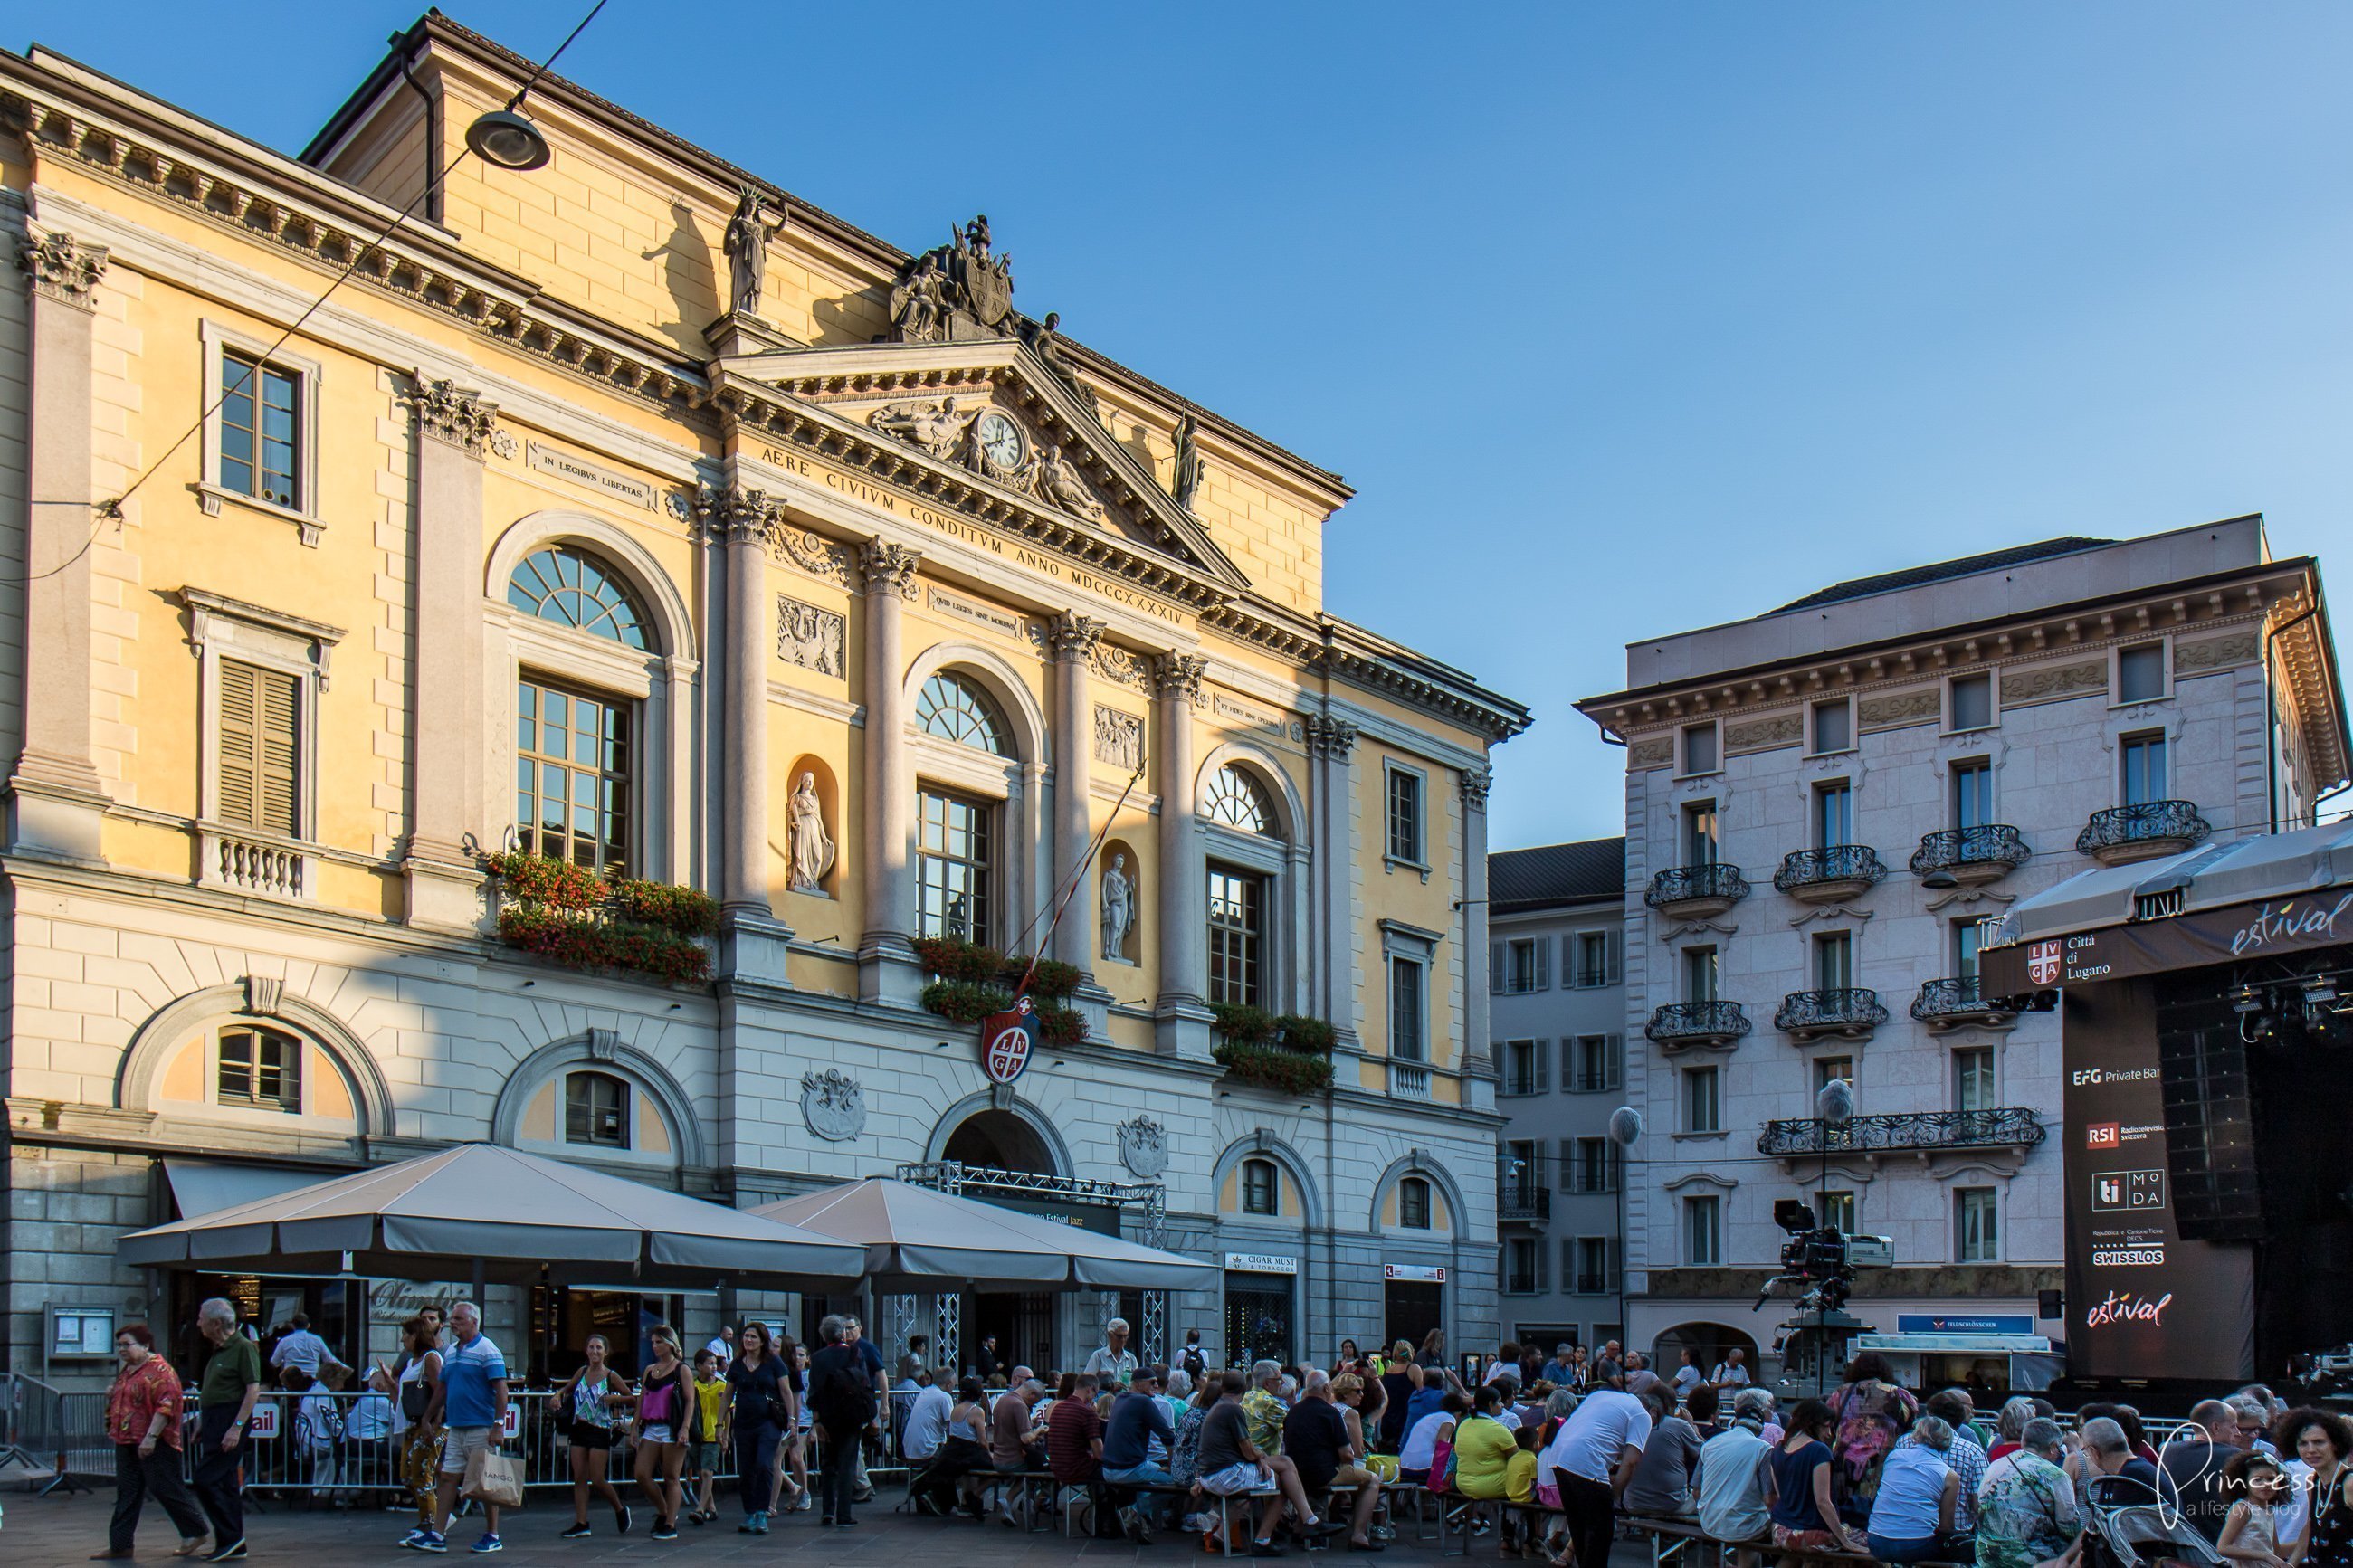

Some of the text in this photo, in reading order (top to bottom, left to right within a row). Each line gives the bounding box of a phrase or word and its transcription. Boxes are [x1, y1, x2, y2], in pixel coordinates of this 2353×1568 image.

[544, 456, 643, 498] IN LEGIBVS LIBERTAS
[762, 448, 1182, 623] AERE CIVIVM CONDITVM ANNO MDCCCXXXXIV
[2230, 892, 2353, 955] estival
[2067, 934, 2095, 949] Città
[2067, 952, 2078, 964] di
[2067, 964, 2110, 980] Lugano
[2073, 1069, 2101, 1086] EFG
[2105, 1069, 2141, 1082] Private
[2089, 1127, 2115, 1143] RSI
[2120, 1133, 2147, 1141] svizzera
[2101, 1179, 2119, 1203] ti
[1070, 1216, 1084, 1226] Jazz
[1248, 1255, 1294, 1266] CIGAR MUST
[2093, 1251, 2164, 1265] SWISSLOS
[2087, 1290, 2173, 1328] estival
